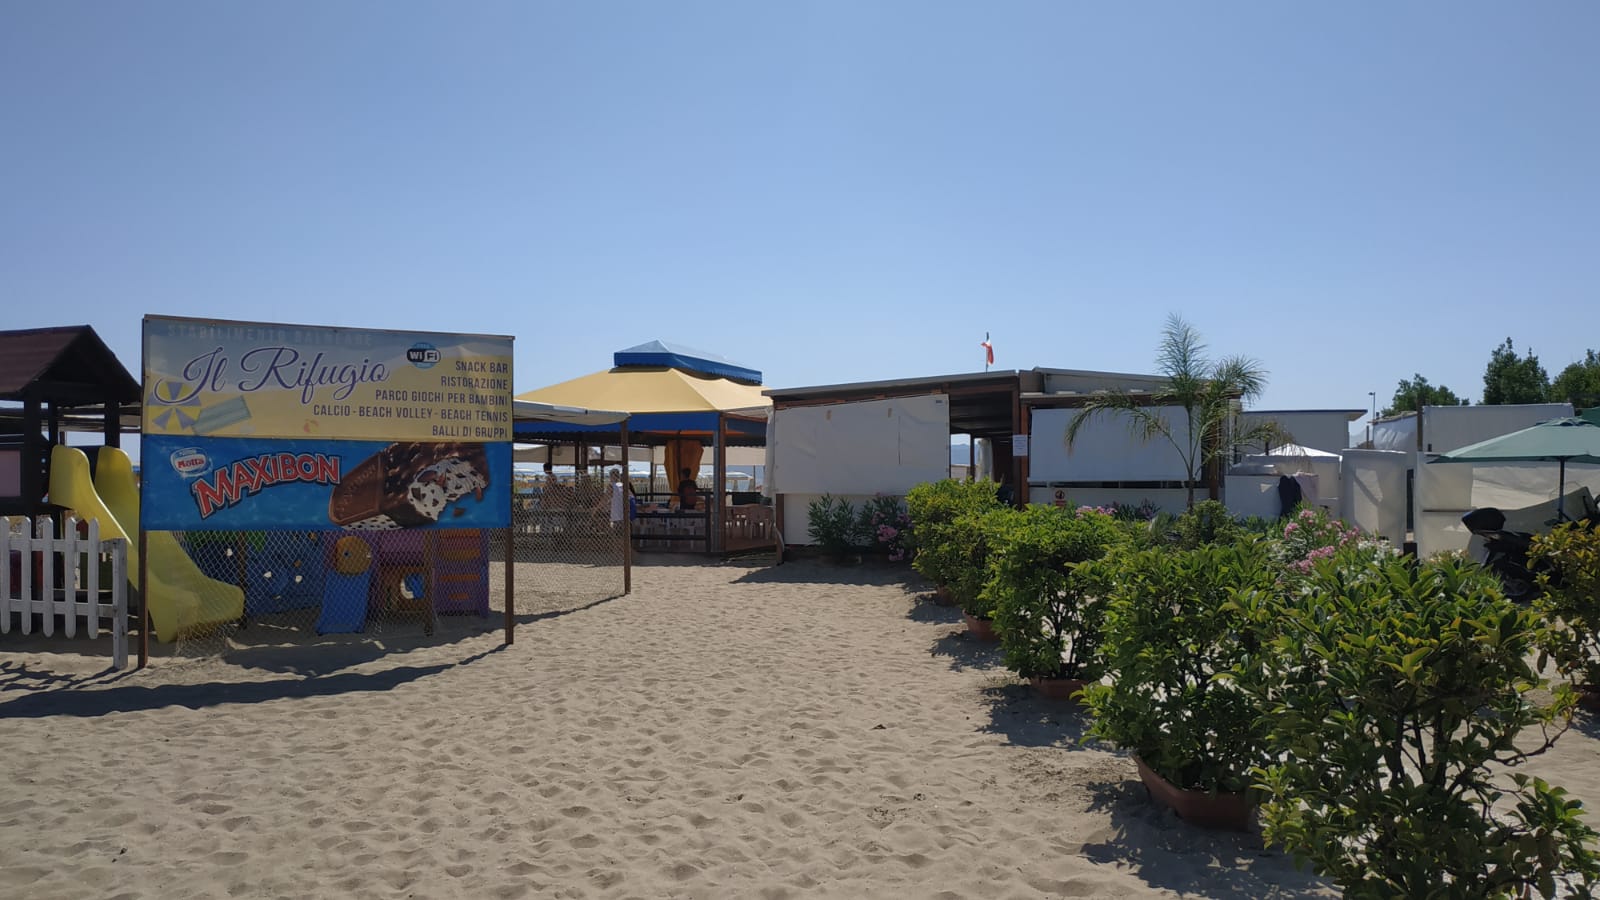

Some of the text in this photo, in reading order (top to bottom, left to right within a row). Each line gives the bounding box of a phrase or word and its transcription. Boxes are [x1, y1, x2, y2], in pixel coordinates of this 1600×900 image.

[455, 360, 509, 374] SNACK BAR
[237, 346, 390, 405] Rifugio
[441, 376, 508, 390] RISTORAZIONE
[375, 389, 508, 407] PARCO GIOCHI PER BAMBINI
[313, 404, 350, 417] CALCIO
[358, 406, 392, 418] BEACH
[396, 407, 433, 419] VOLLEY
[441, 409, 472, 421] BEACH
[476, 410, 508, 423] TENNIS
[432, 425, 508, 439] BALLI DI GRUPPI
[177, 458, 205, 469] Motta
[192, 453, 341, 518] MAXIBON
